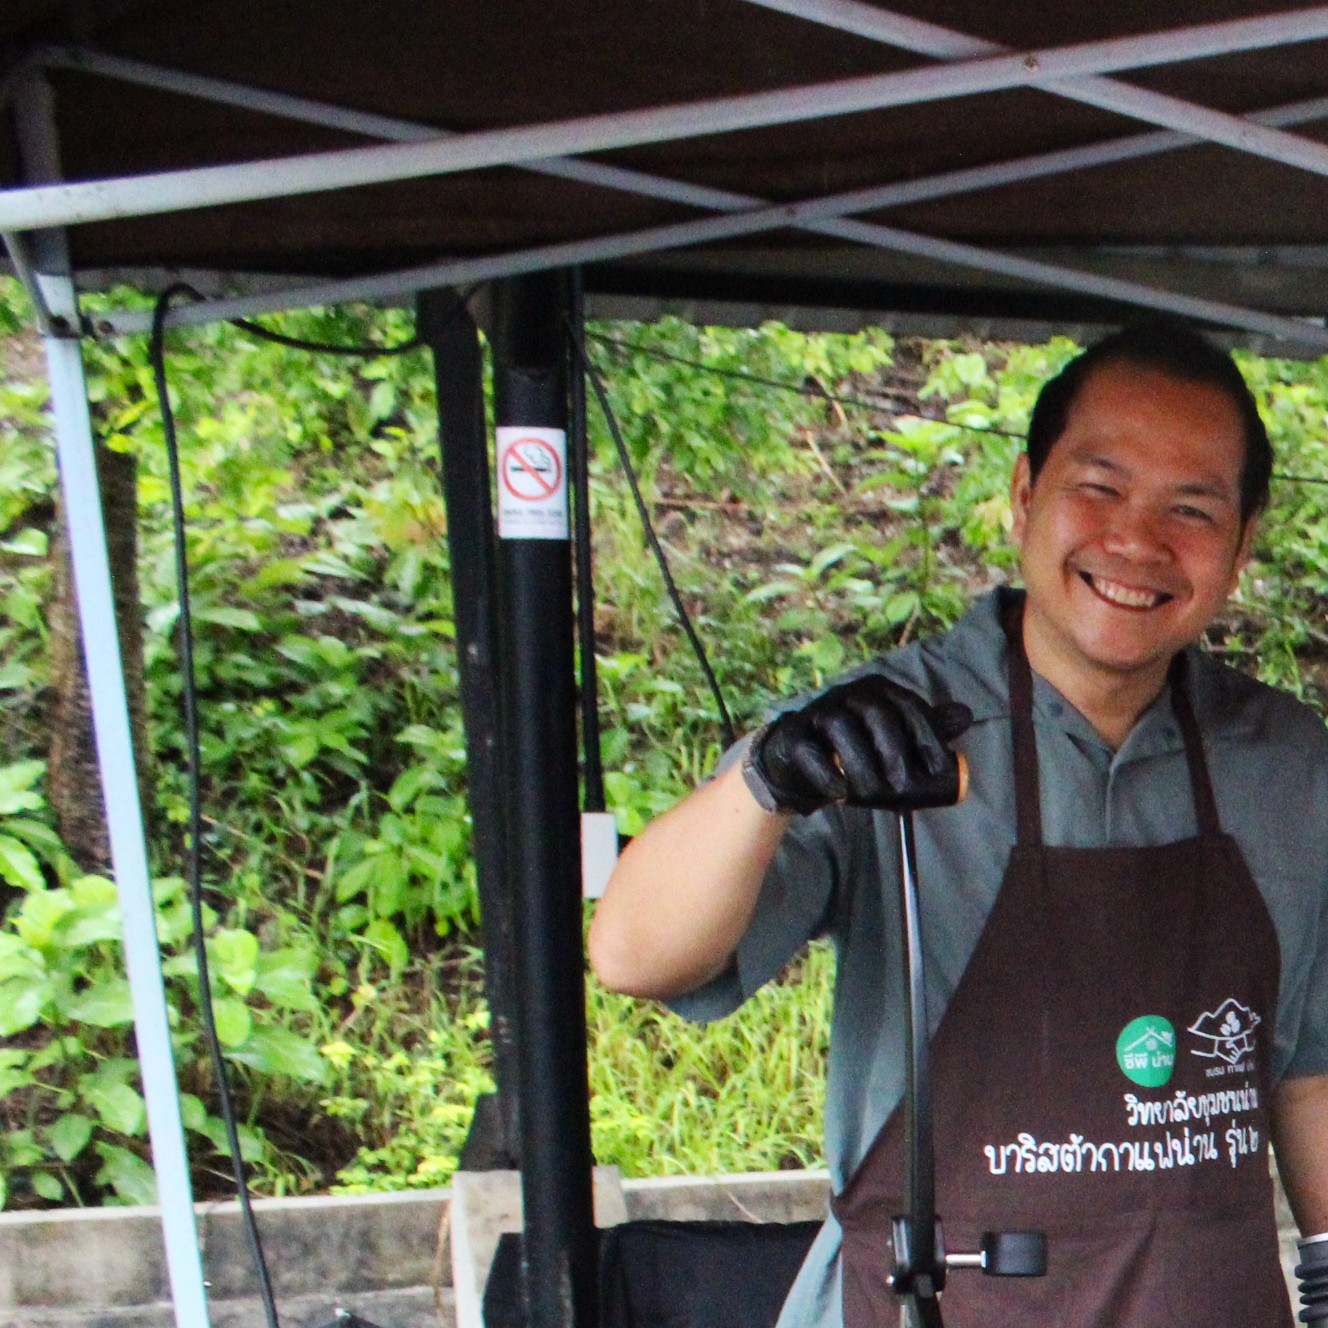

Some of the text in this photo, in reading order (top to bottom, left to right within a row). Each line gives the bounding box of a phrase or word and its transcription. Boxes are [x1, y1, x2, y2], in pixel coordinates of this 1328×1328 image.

[983, 1127, 1219, 1175] บาริสต้ากาแฟน่าน
